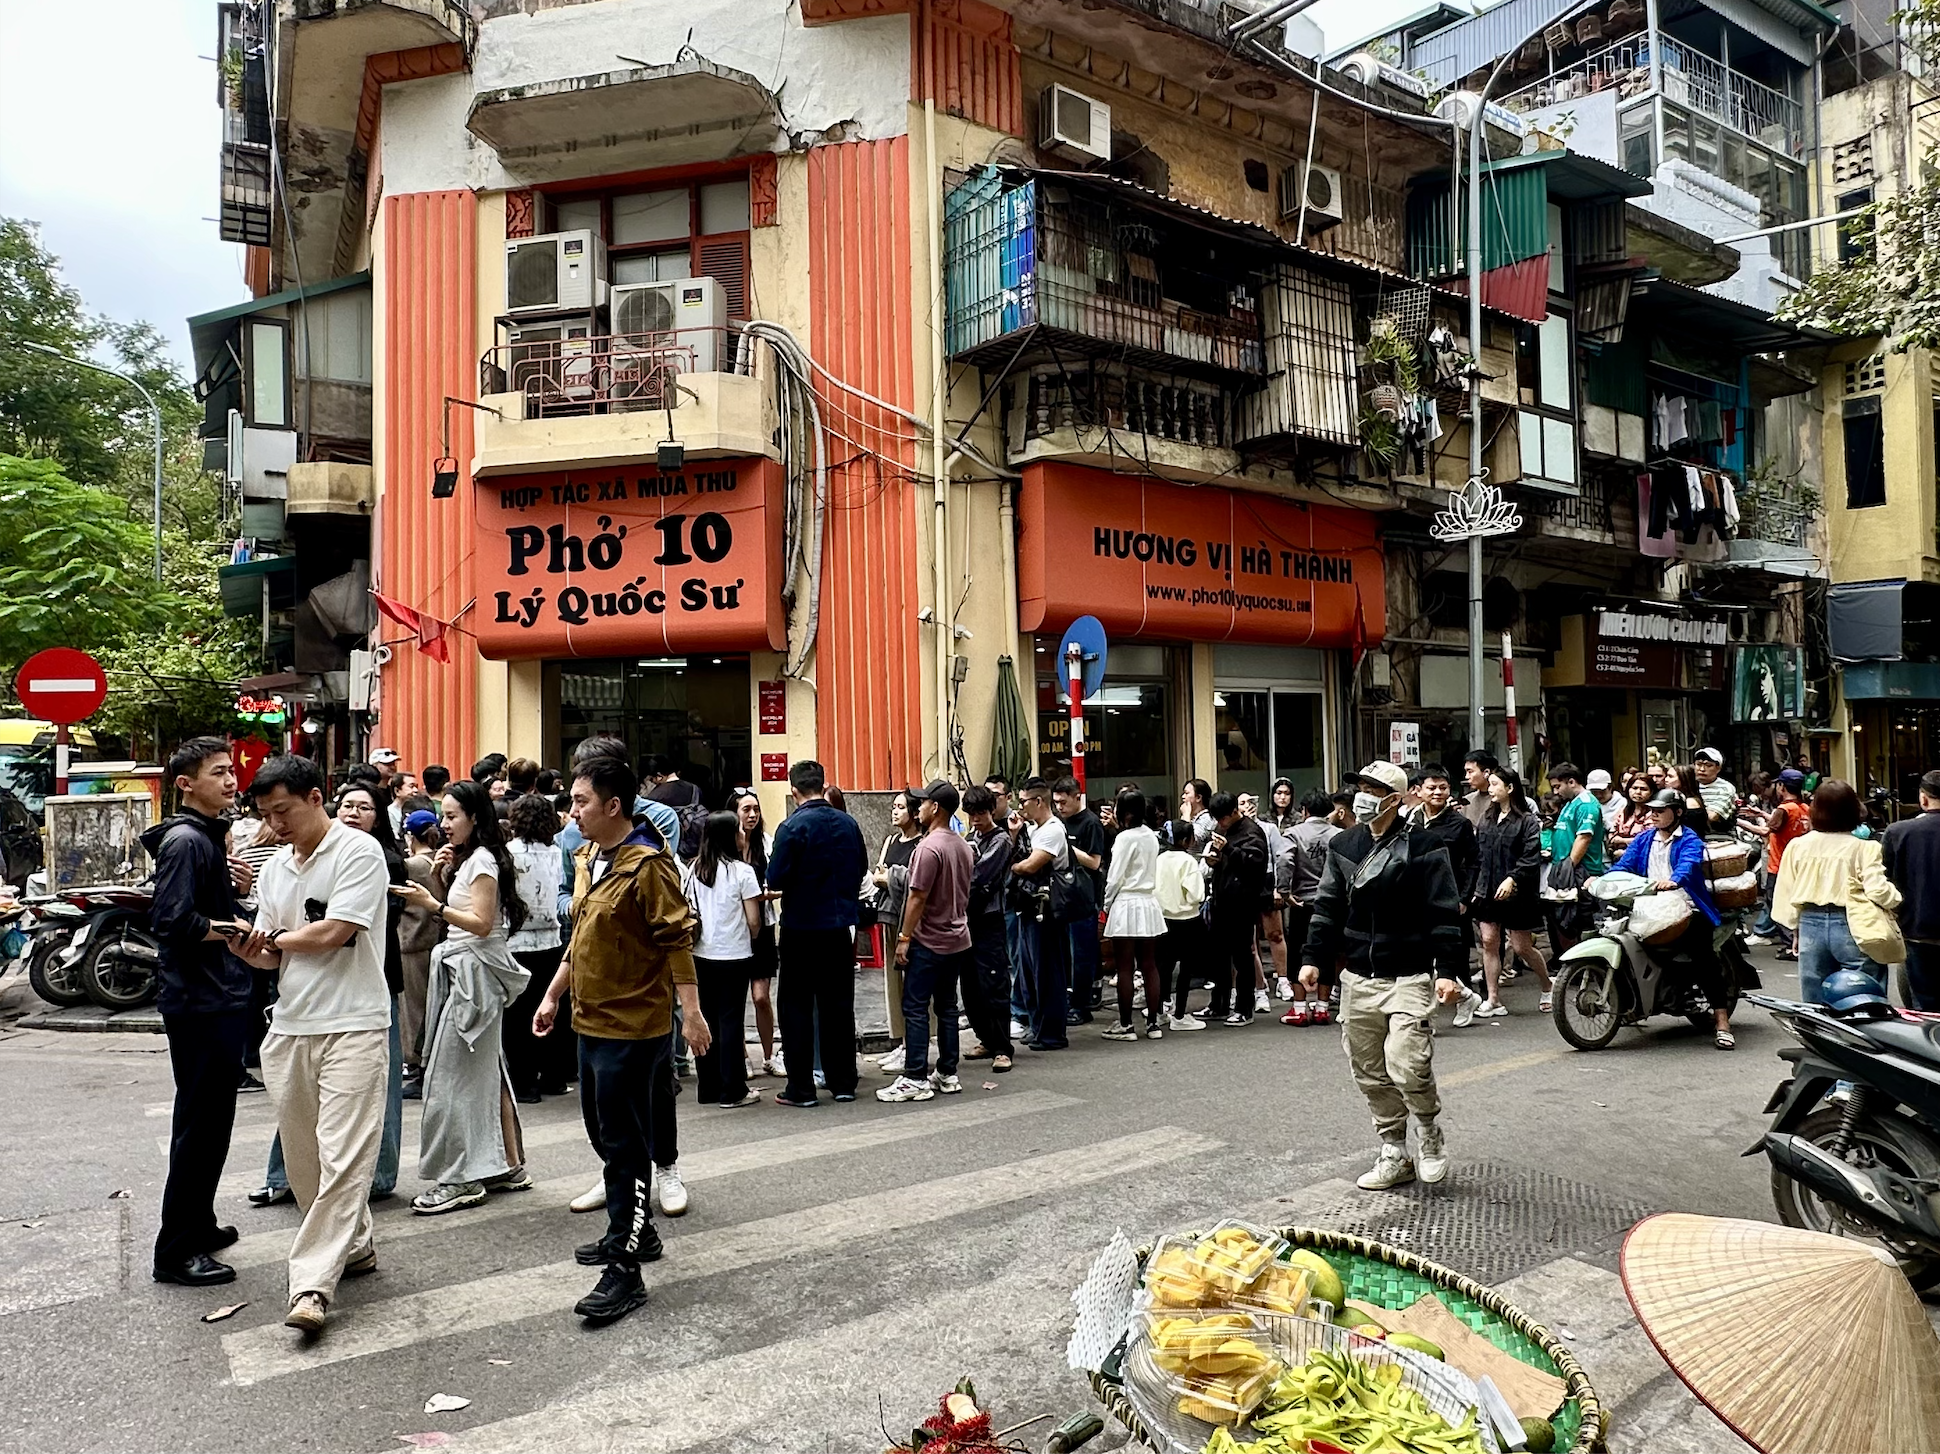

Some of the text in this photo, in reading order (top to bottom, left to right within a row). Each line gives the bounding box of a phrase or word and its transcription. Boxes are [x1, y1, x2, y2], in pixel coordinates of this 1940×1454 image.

[500, 470, 737, 511] HỢP TÁC XÃ MÙA THU
[506, 511, 733, 576] Phở 10
[1094, 526, 1353, 584] HƯƠNG VỊ HÀ THÀNH
[494, 576, 744, 628] Lý Quốc Sư
[1048, 720, 1090, 737] OPN
